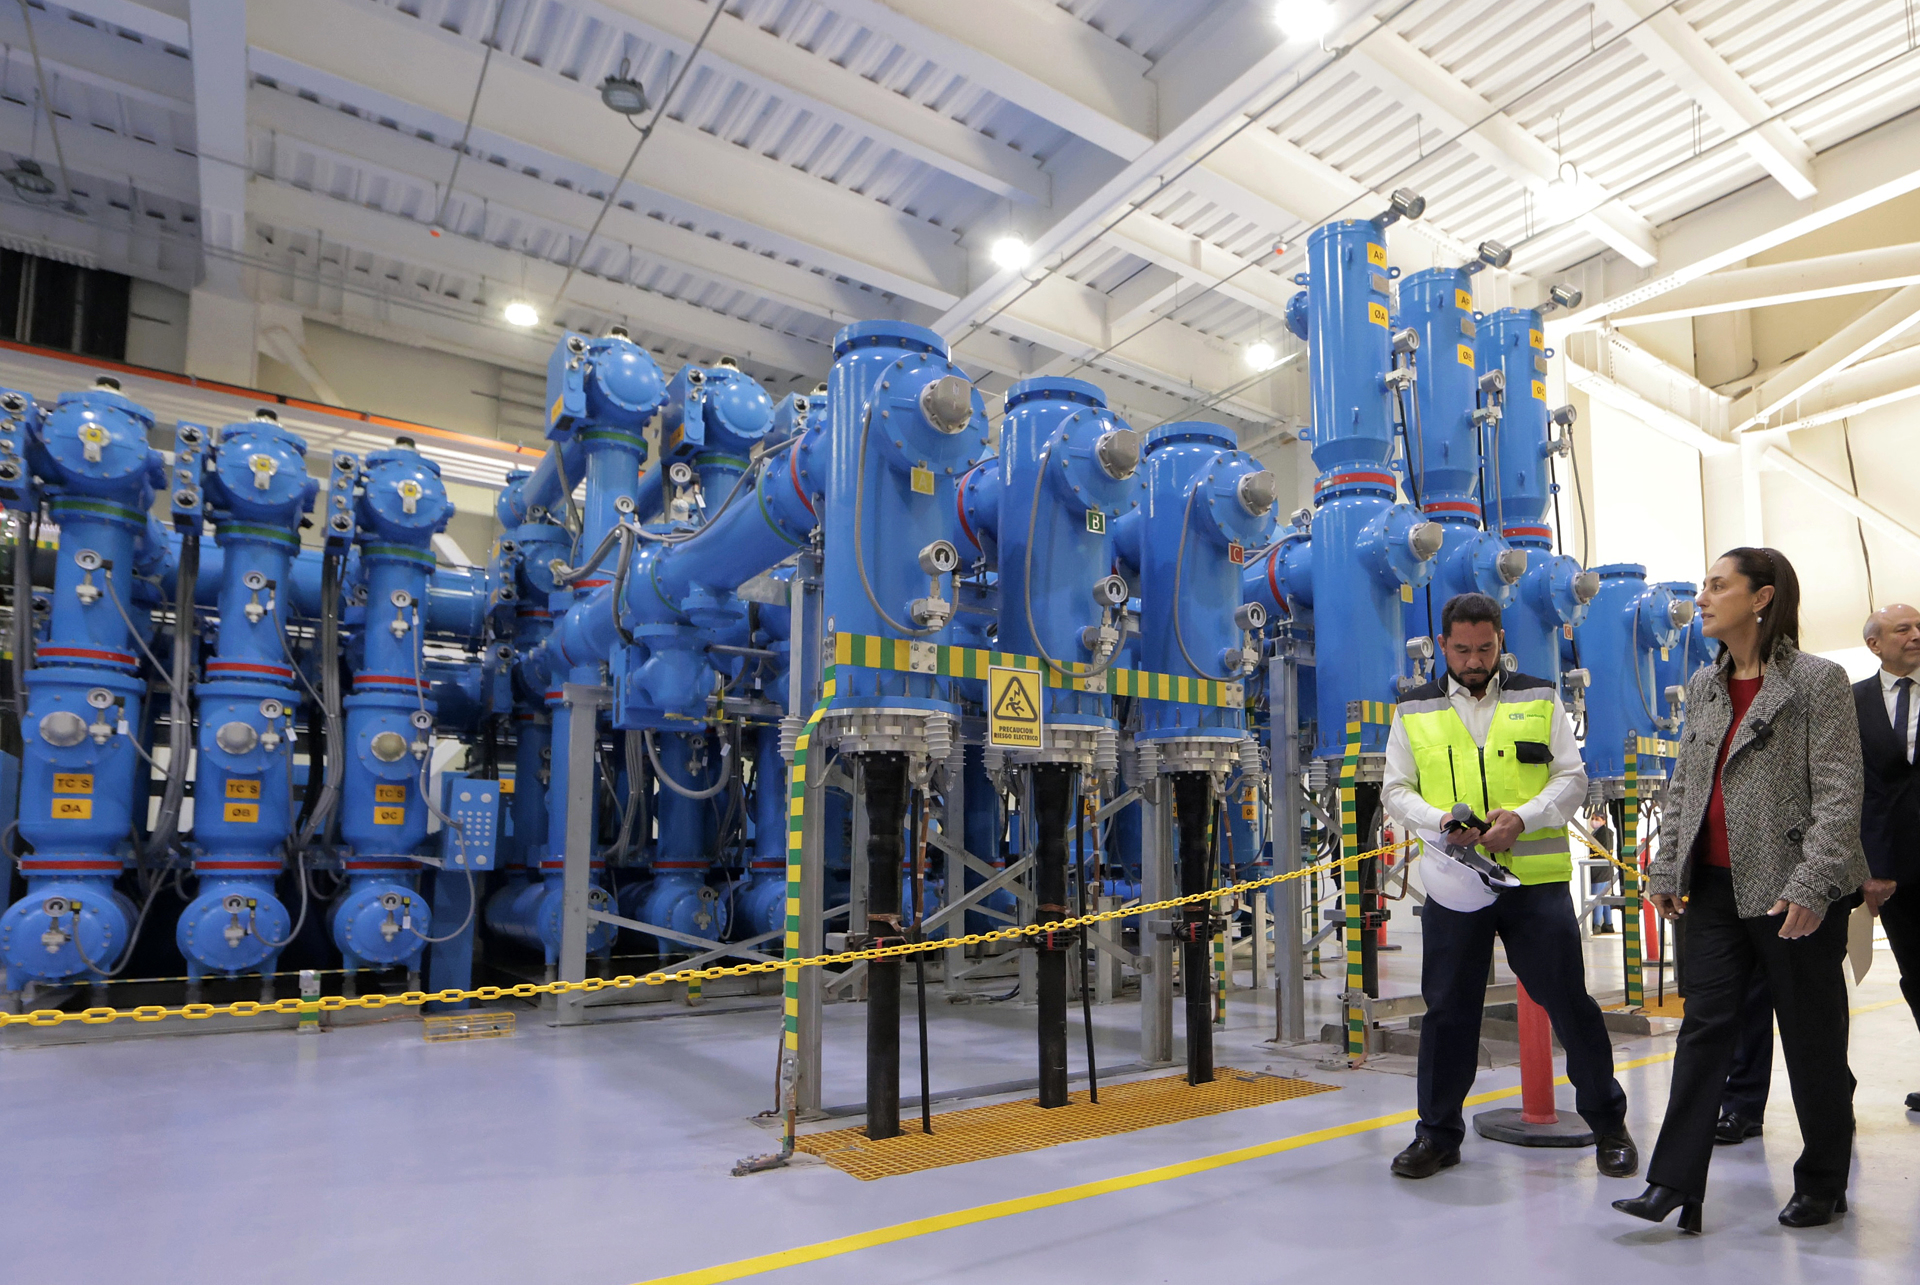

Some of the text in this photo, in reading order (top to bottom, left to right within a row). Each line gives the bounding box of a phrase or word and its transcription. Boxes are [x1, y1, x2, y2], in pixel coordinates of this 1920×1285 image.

[1374, 251, 1384, 260] AP
[918, 473, 928, 490] A
[1092, 514, 1100, 530] B
[1233, 547, 1240, 561] C
[998, 725, 1034, 734] PRECAUCION
[994, 732, 1012, 740] RIESGO
